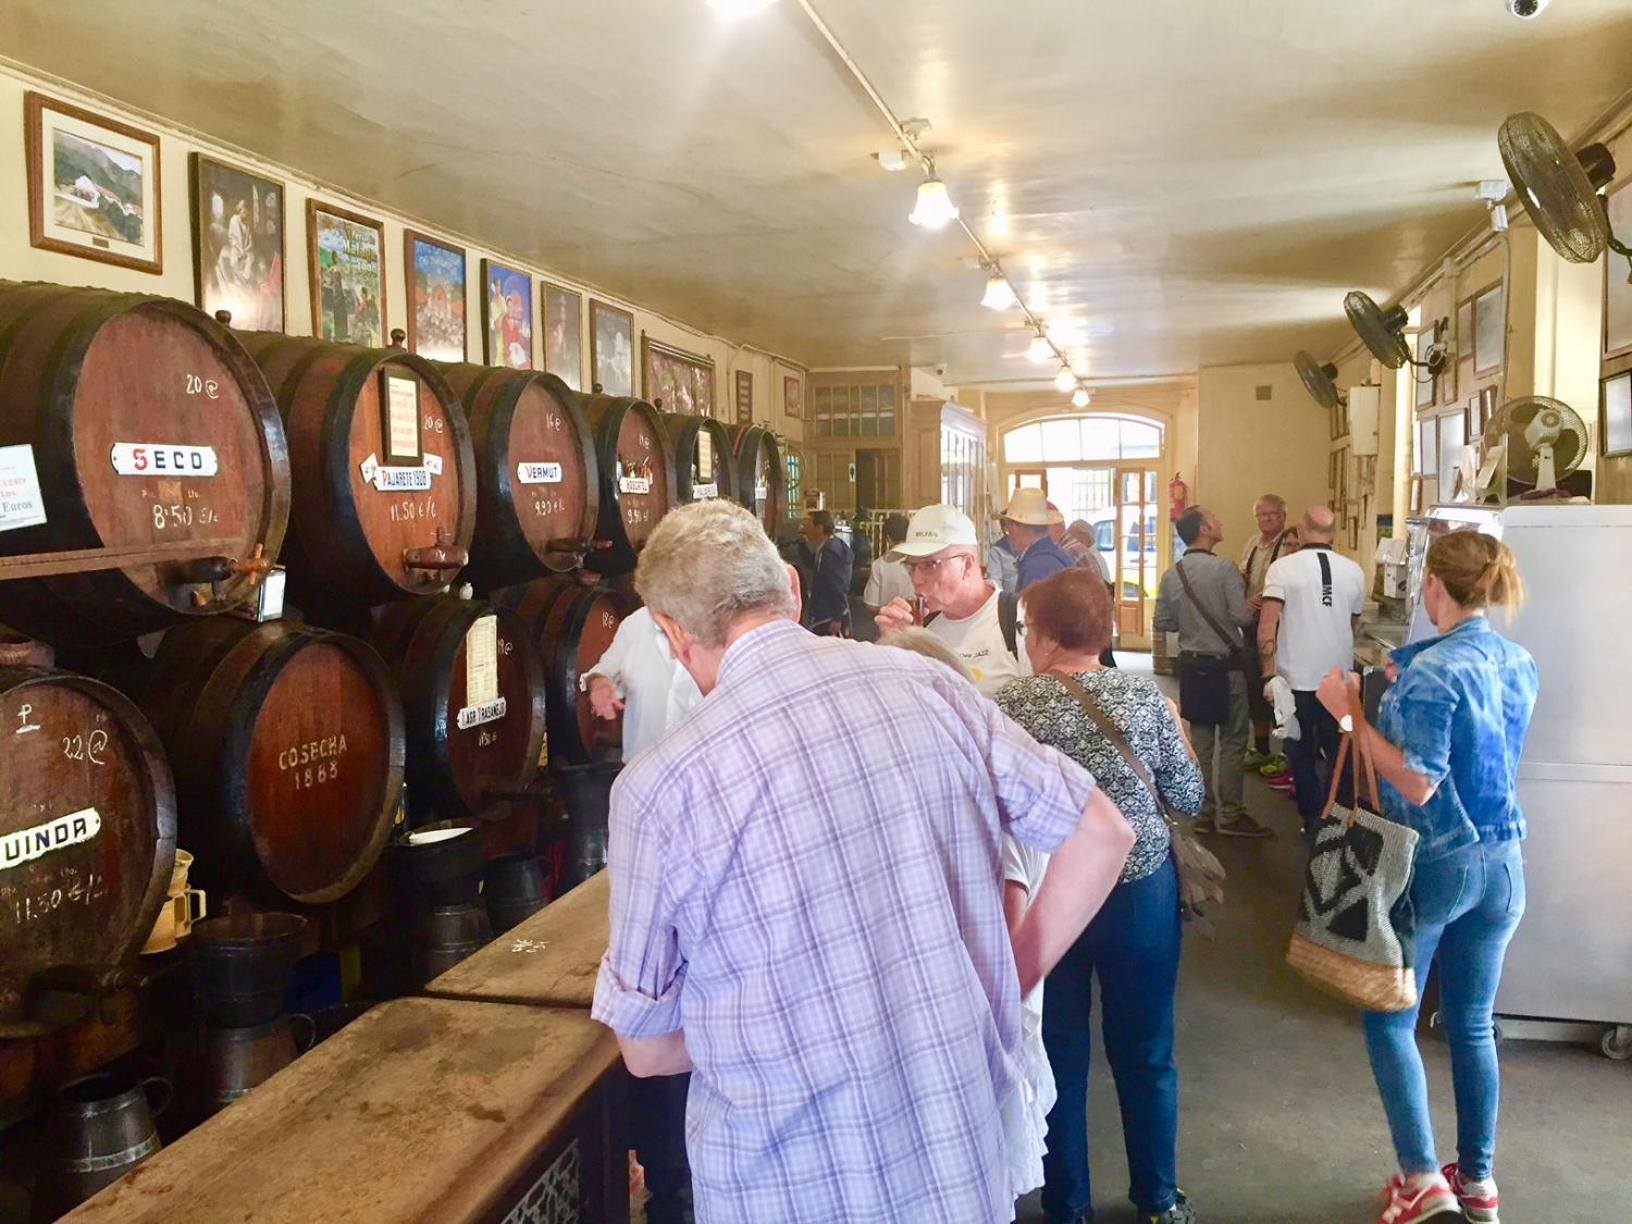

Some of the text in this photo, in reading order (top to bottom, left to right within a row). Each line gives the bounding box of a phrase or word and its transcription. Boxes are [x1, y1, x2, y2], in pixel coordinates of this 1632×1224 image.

[186, 374, 202, 394] 20
[132, 448, 203, 471] SECO
[382, 470, 412, 487] PAJARETE
[526, 466, 558, 479] VERMUT
[3, 501, 32, 513] Euros
[62, 734, 84, 760] 22
[279, 733, 348, 771] COSECHA
[5, 817, 87, 861] UINDA
